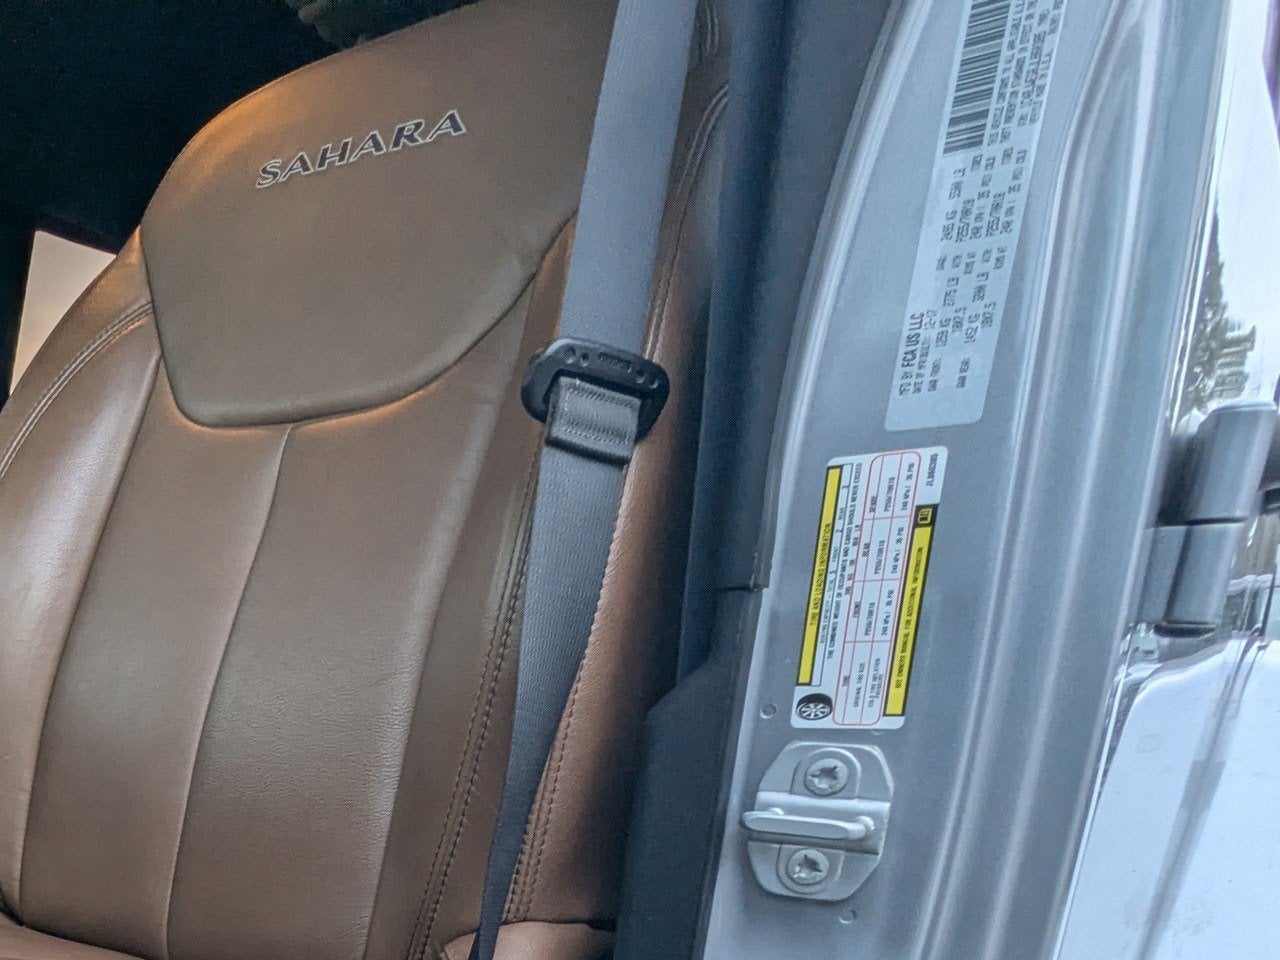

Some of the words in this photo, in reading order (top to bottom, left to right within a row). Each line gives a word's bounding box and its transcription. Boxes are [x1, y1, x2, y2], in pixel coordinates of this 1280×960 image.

[255, 109, 467, 189] SAHARA
[908, 311, 925, 330] LLC
[904, 332, 921, 346] US
[900, 348, 917, 367] FCA
[812, 597, 820, 609] AND
